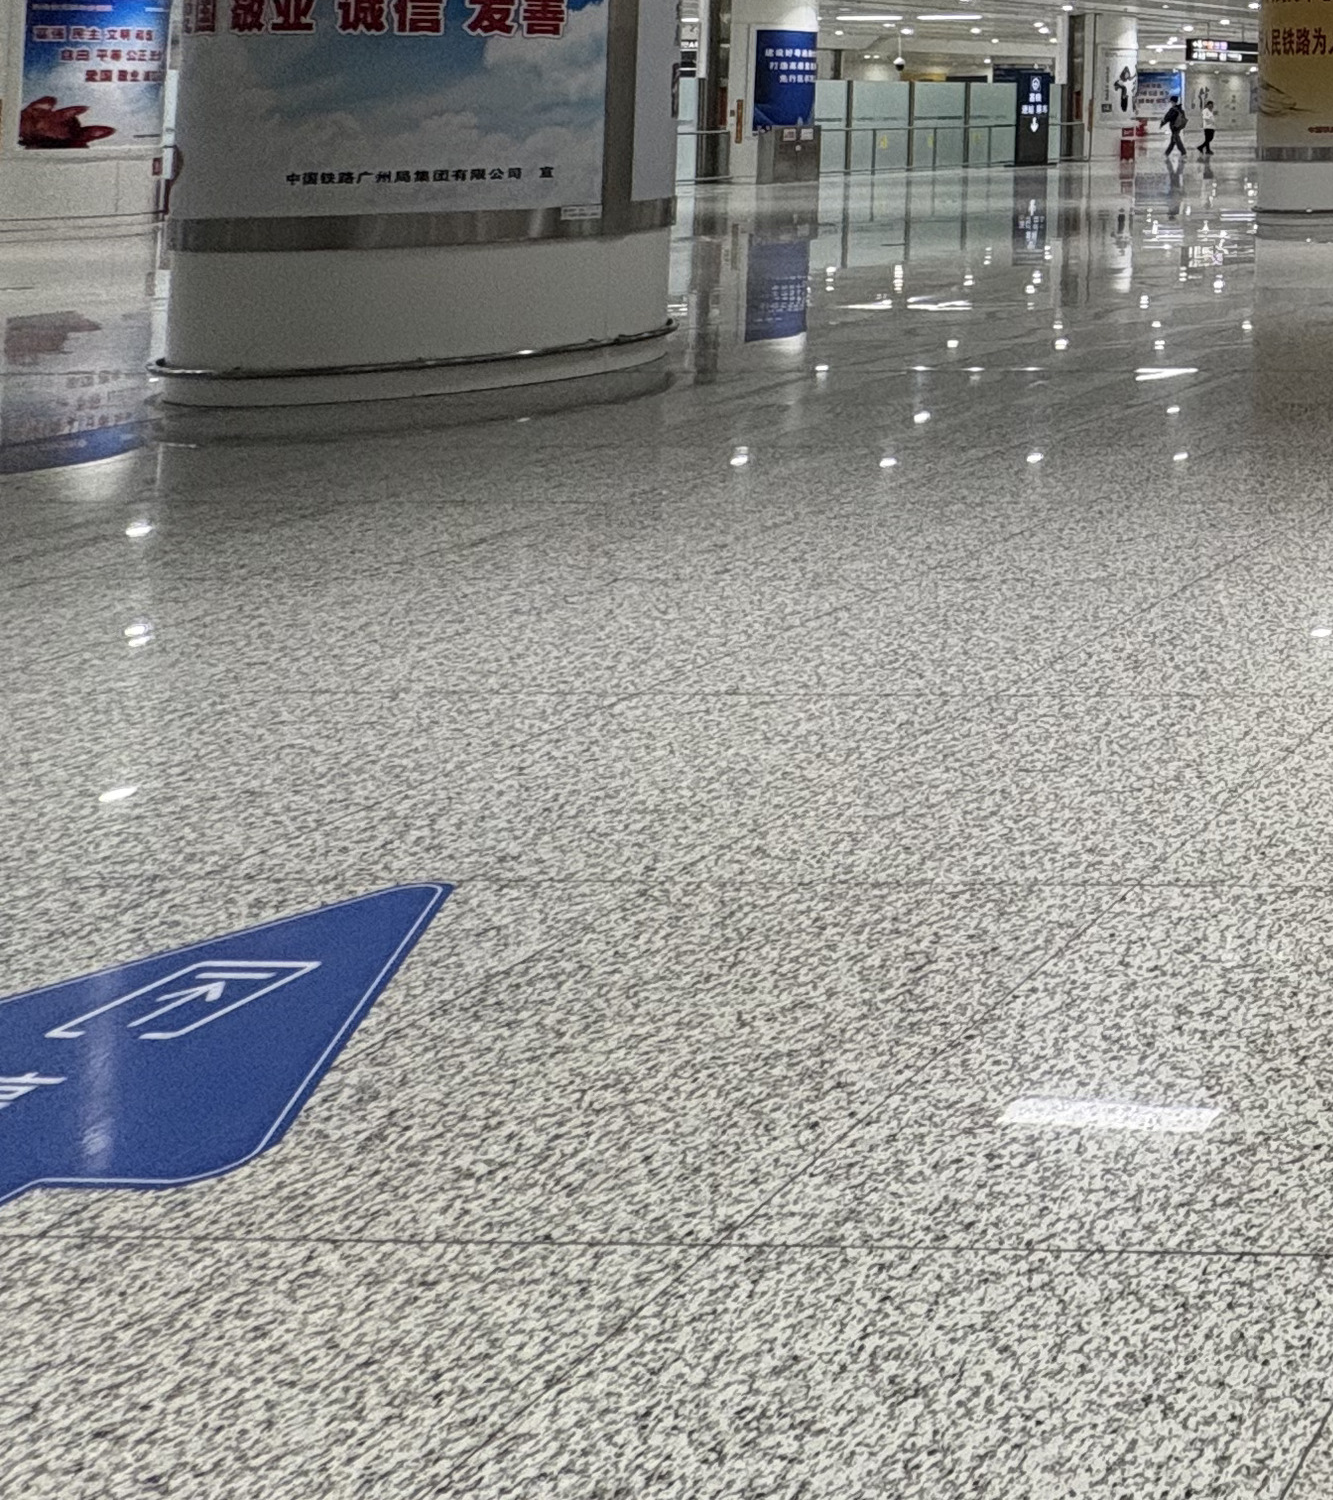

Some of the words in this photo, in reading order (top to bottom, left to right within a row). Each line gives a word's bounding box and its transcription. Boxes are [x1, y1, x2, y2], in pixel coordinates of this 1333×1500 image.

[286, 167, 522, 186] 中国铁路广州局集团有限公司
[539, 166, 554, 179] 宣
